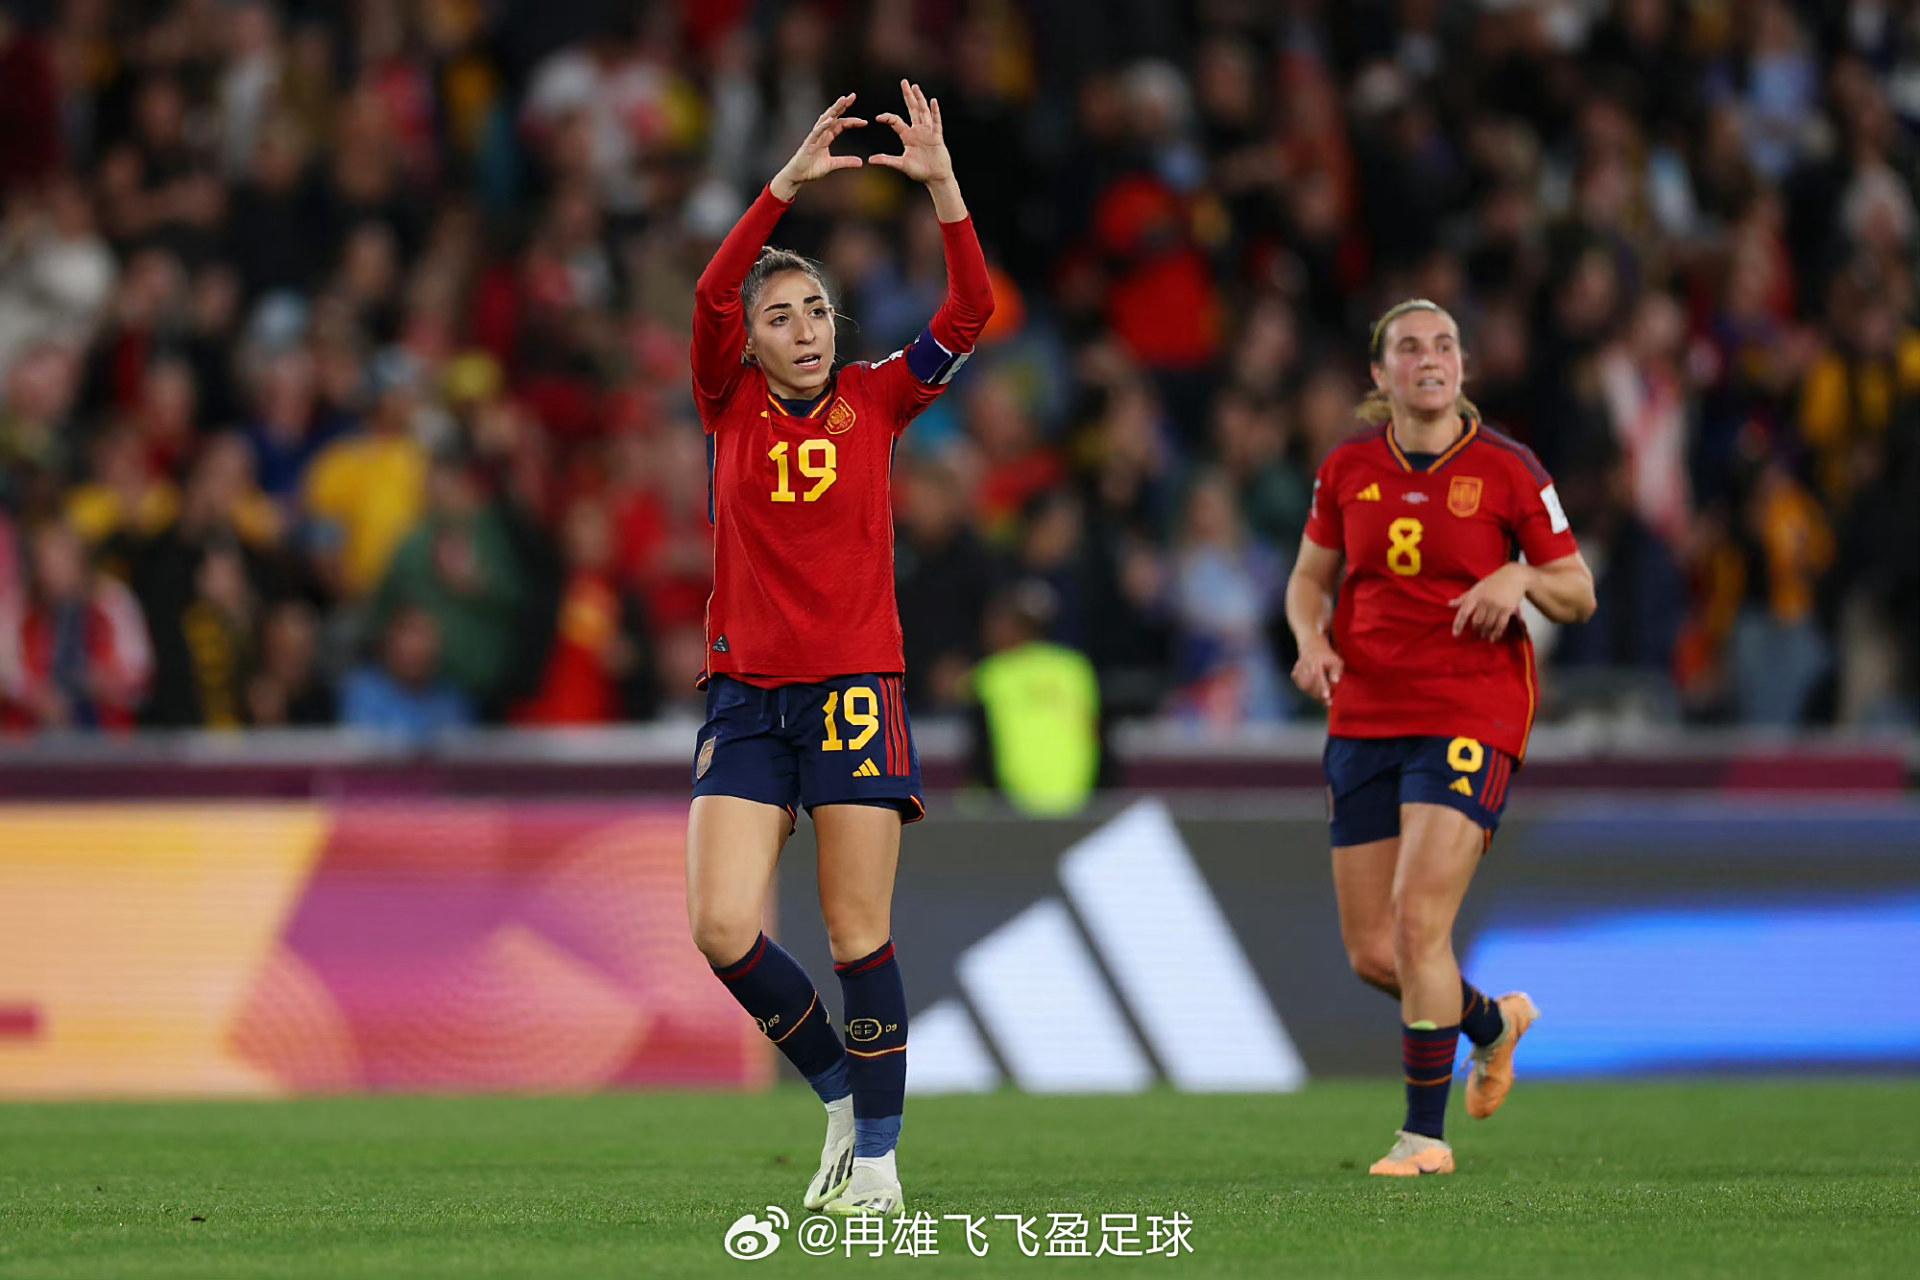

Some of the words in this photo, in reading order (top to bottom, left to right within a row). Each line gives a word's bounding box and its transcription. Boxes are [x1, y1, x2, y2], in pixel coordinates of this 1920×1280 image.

[768, 438, 837, 502] 19
[1387, 517, 1424, 576] 8
[821, 686, 879, 752] 19
